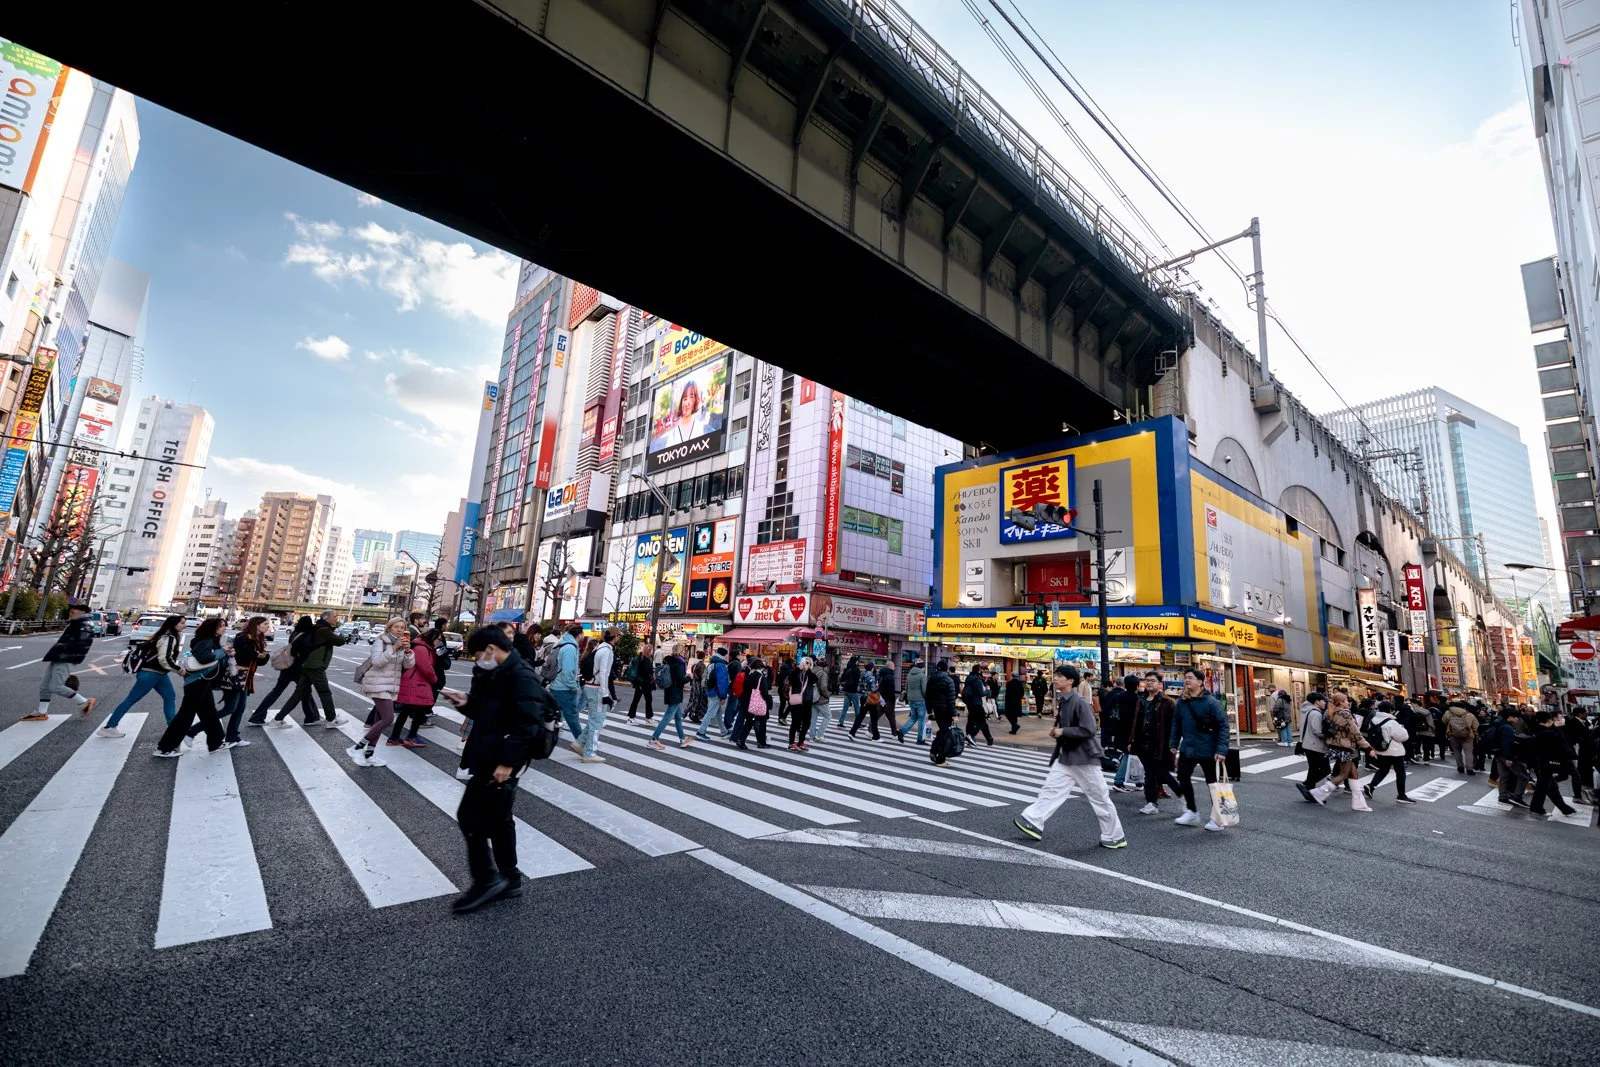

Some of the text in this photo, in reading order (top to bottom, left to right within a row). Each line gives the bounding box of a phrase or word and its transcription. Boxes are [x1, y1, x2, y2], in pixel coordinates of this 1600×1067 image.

[657, 438, 710, 464] TOKYO MX
[953, 486, 997, 499] SHISEIDO
[142, 490, 167, 539] OFFICE
[954, 512, 991, 525] Kanebo
[956, 526, 989, 536] SOFINA
[1410, 586, 1422, 607] KFC
[757, 597, 783, 610] LOVE
[1081, 622, 1168, 631] Matsmoto KiYoshi
